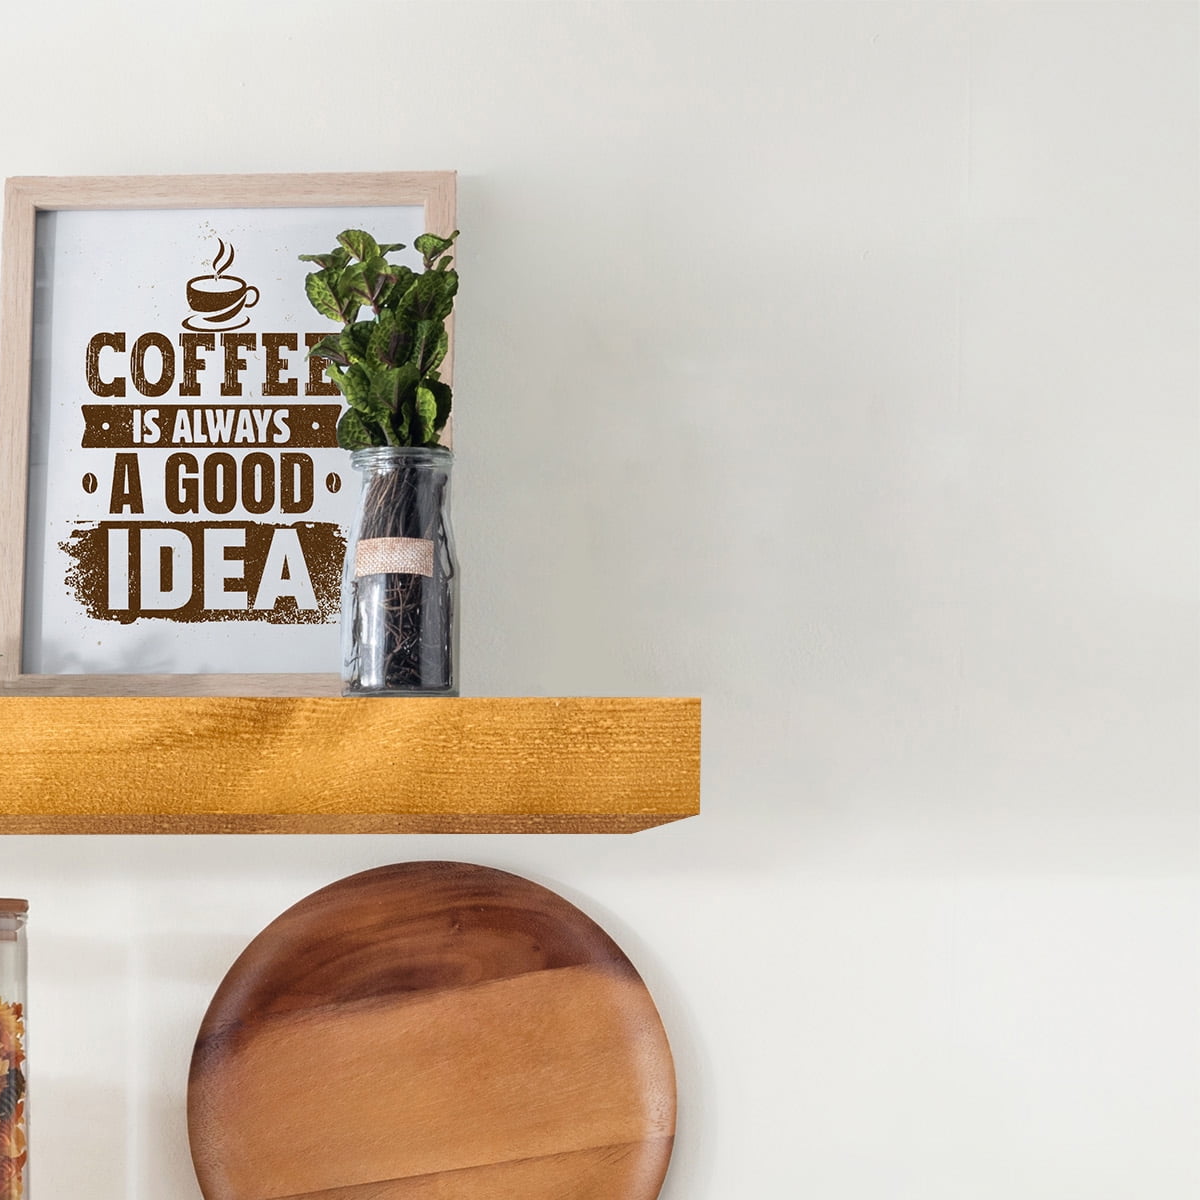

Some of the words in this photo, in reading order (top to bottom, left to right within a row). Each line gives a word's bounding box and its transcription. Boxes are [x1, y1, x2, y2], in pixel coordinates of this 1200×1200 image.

[86, 332, 341, 397] COFFEE
[133, 409, 161, 443] IS
[172, 408, 290, 444] ALWAYS
[109, 453, 143, 514] A
[165, 452, 314, 514] GOOD
[108, 528, 317, 610] IDEA
